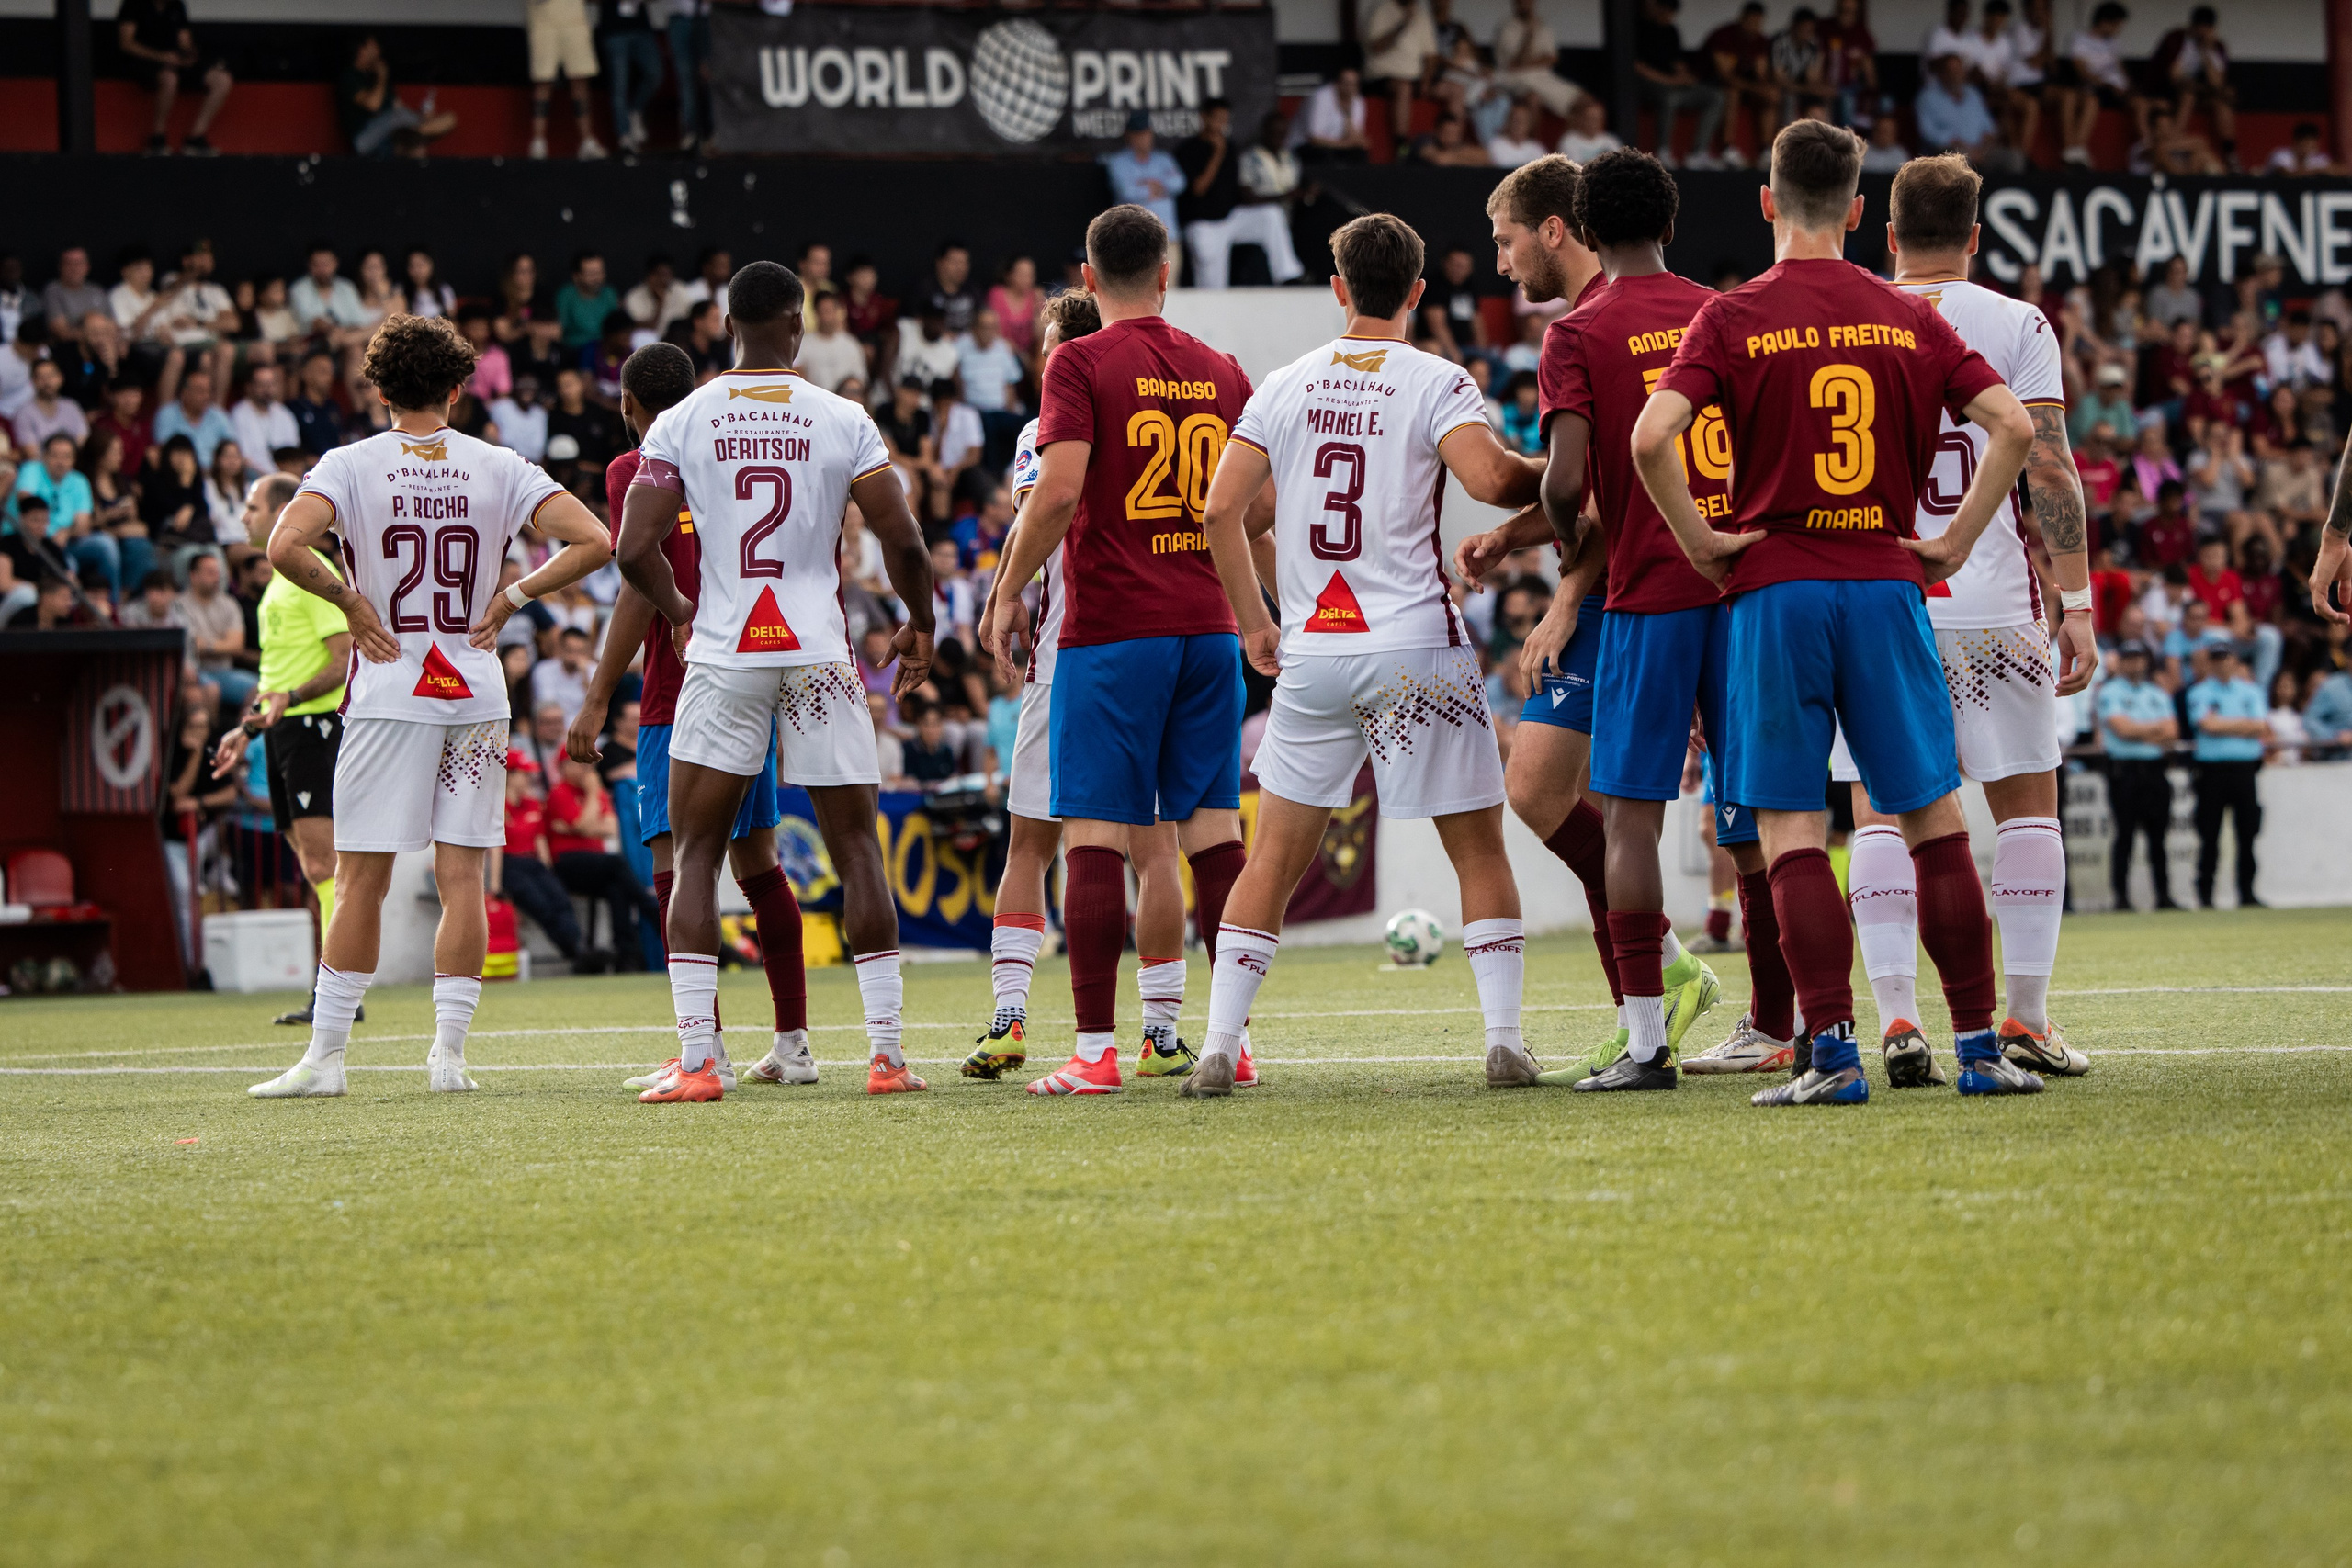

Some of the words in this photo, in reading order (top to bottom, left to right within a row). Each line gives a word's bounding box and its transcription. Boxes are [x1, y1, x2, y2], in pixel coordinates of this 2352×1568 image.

[759, 47, 966, 108] WORLD
[1072, 50, 1232, 108] PRINT
[1747, 326, 1820, 359] PAULO
[1828, 323, 1917, 350] FREITAS
[1136, 378, 1216, 400] BARROSO
[1306, 379, 1396, 397] D'BACALHAU
[710, 411, 814, 429] D'BACALHAU
[1306, 408, 1363, 436] MANEL
[1367, 411, 1384, 436] E.
[1809, 363, 1876, 496] 3
[714, 437, 811, 462] DERITSON
[386, 467, 470, 483] D'BACALHAU
[1125, 409, 1228, 523] 20
[408, 483, 452, 493] RESTARANTE
[392, 495, 408, 518] P.
[413, 495, 469, 521] ROCHA
[1309, 441, 1366, 562] 3
[734, 465, 792, 579] 2
[1805, 505, 1883, 530] MARIA
[381, 524, 480, 634] 29
[1318, 608, 1357, 620] DELTA
[749, 626, 790, 639] DELTA
[1566, 675, 1590, 685] PORTELA
[1991, 888, 2056, 897] PLAYOFF
